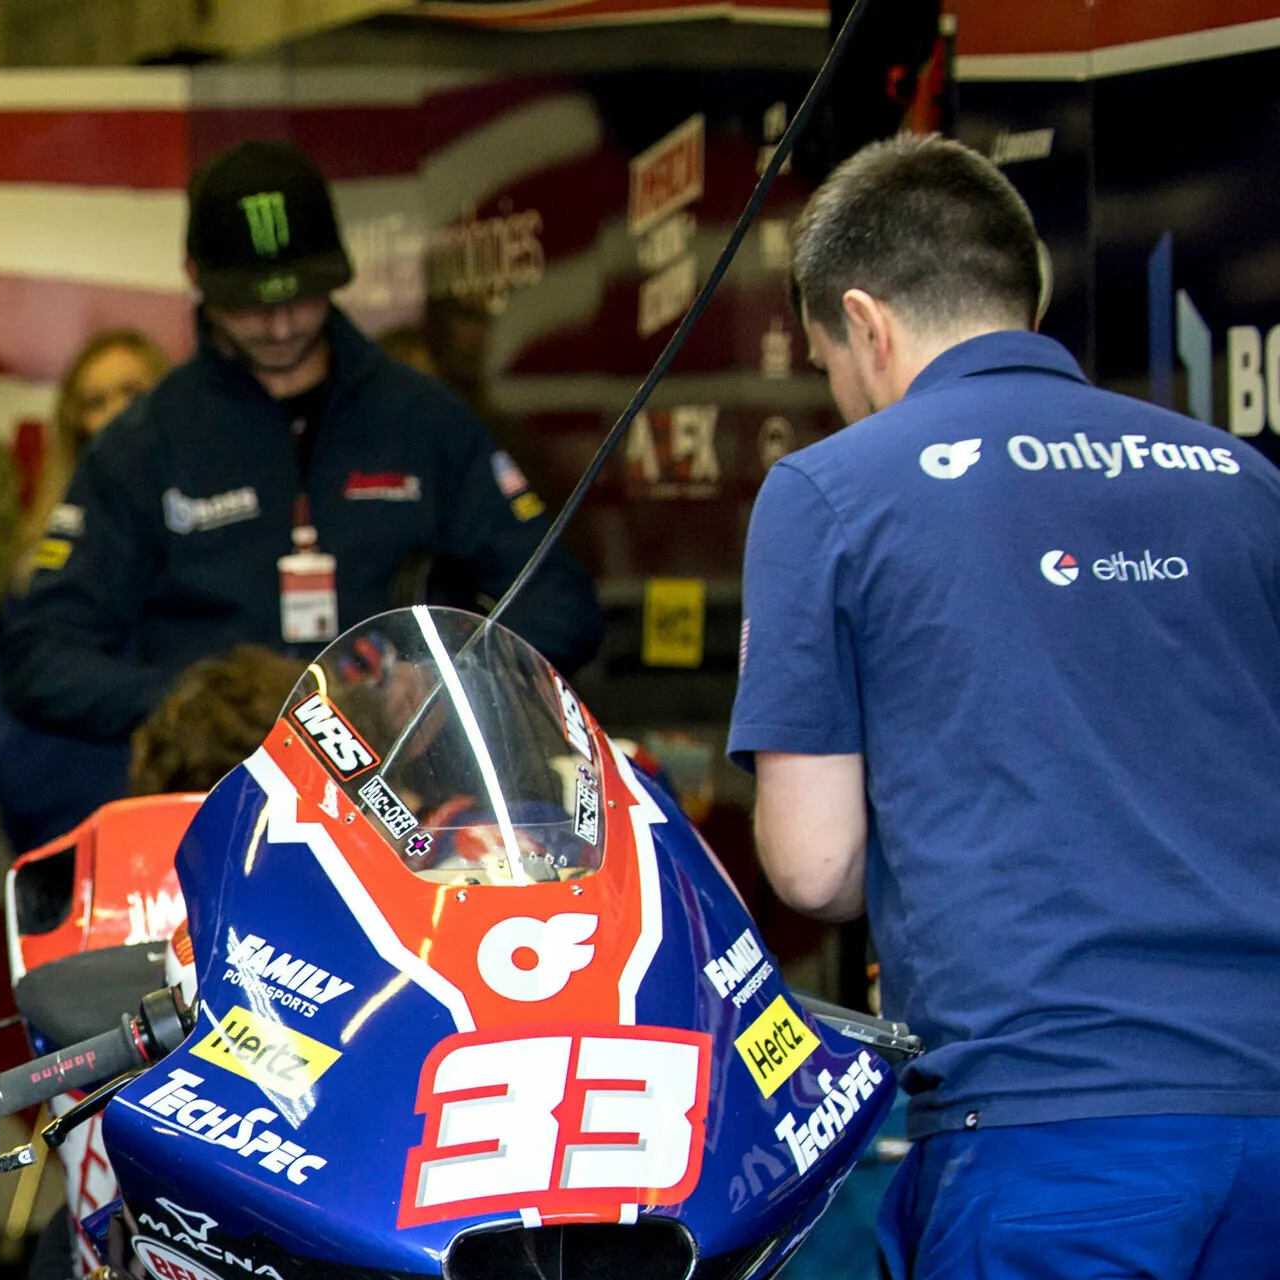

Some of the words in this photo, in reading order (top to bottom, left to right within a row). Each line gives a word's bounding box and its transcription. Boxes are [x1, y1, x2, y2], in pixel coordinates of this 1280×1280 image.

[1007, 432, 1240, 479] OnlyFans
[1092, 550, 1189, 583] ethika
[293, 694, 374, 772] WRS
[223, 969, 319, 1018] POWERSPORTS
[226, 934, 354, 1004] FAMILY
[211, 1020, 310, 1082] Hertz
[747, 1017, 804, 1080] Hertz
[414, 1035, 700, 1208] 33
